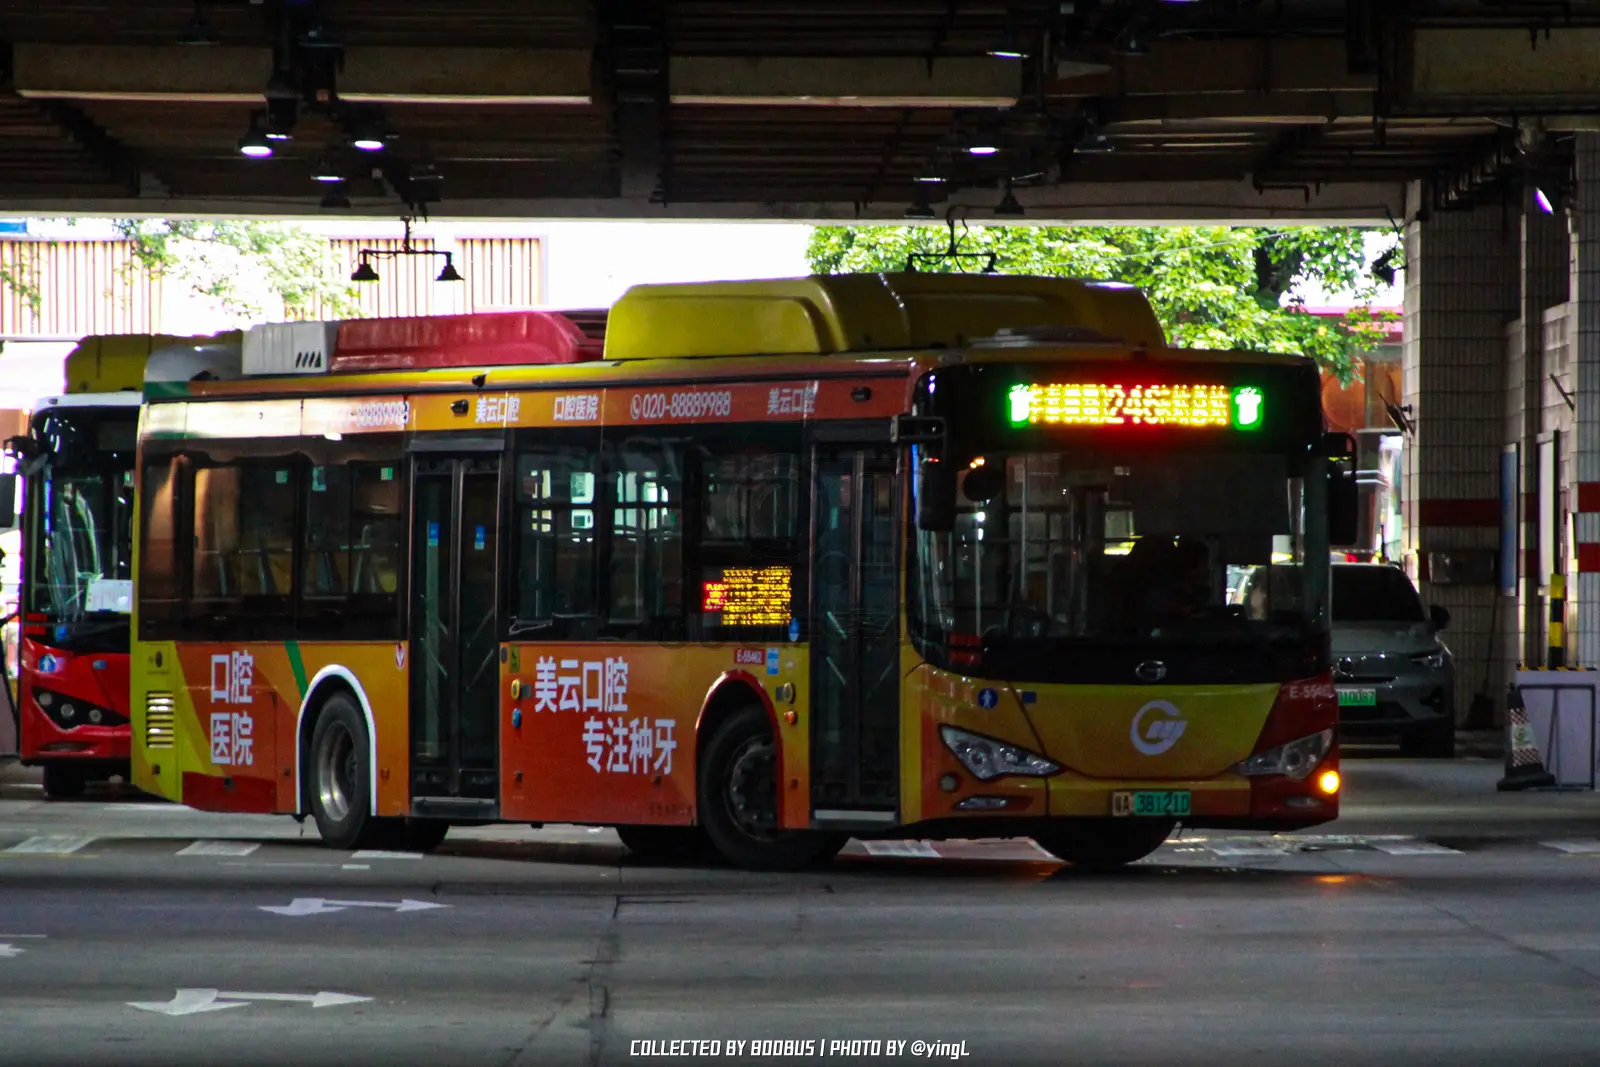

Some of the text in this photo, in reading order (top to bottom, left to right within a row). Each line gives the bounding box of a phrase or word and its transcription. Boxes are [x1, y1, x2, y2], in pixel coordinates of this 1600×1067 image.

[474, 395, 521, 423] 美云口腔
[553, 394, 599, 421] 口腔医院
[642, 391, 732, 419] 020-88889988
[767, 386, 816, 415] 美云口腔
[210, 649, 253, 704] 口腔
[534, 655, 629, 713] 美云口腔
[210, 711, 253, 766] 医院
[582, 716, 677, 775] 专注种牙
